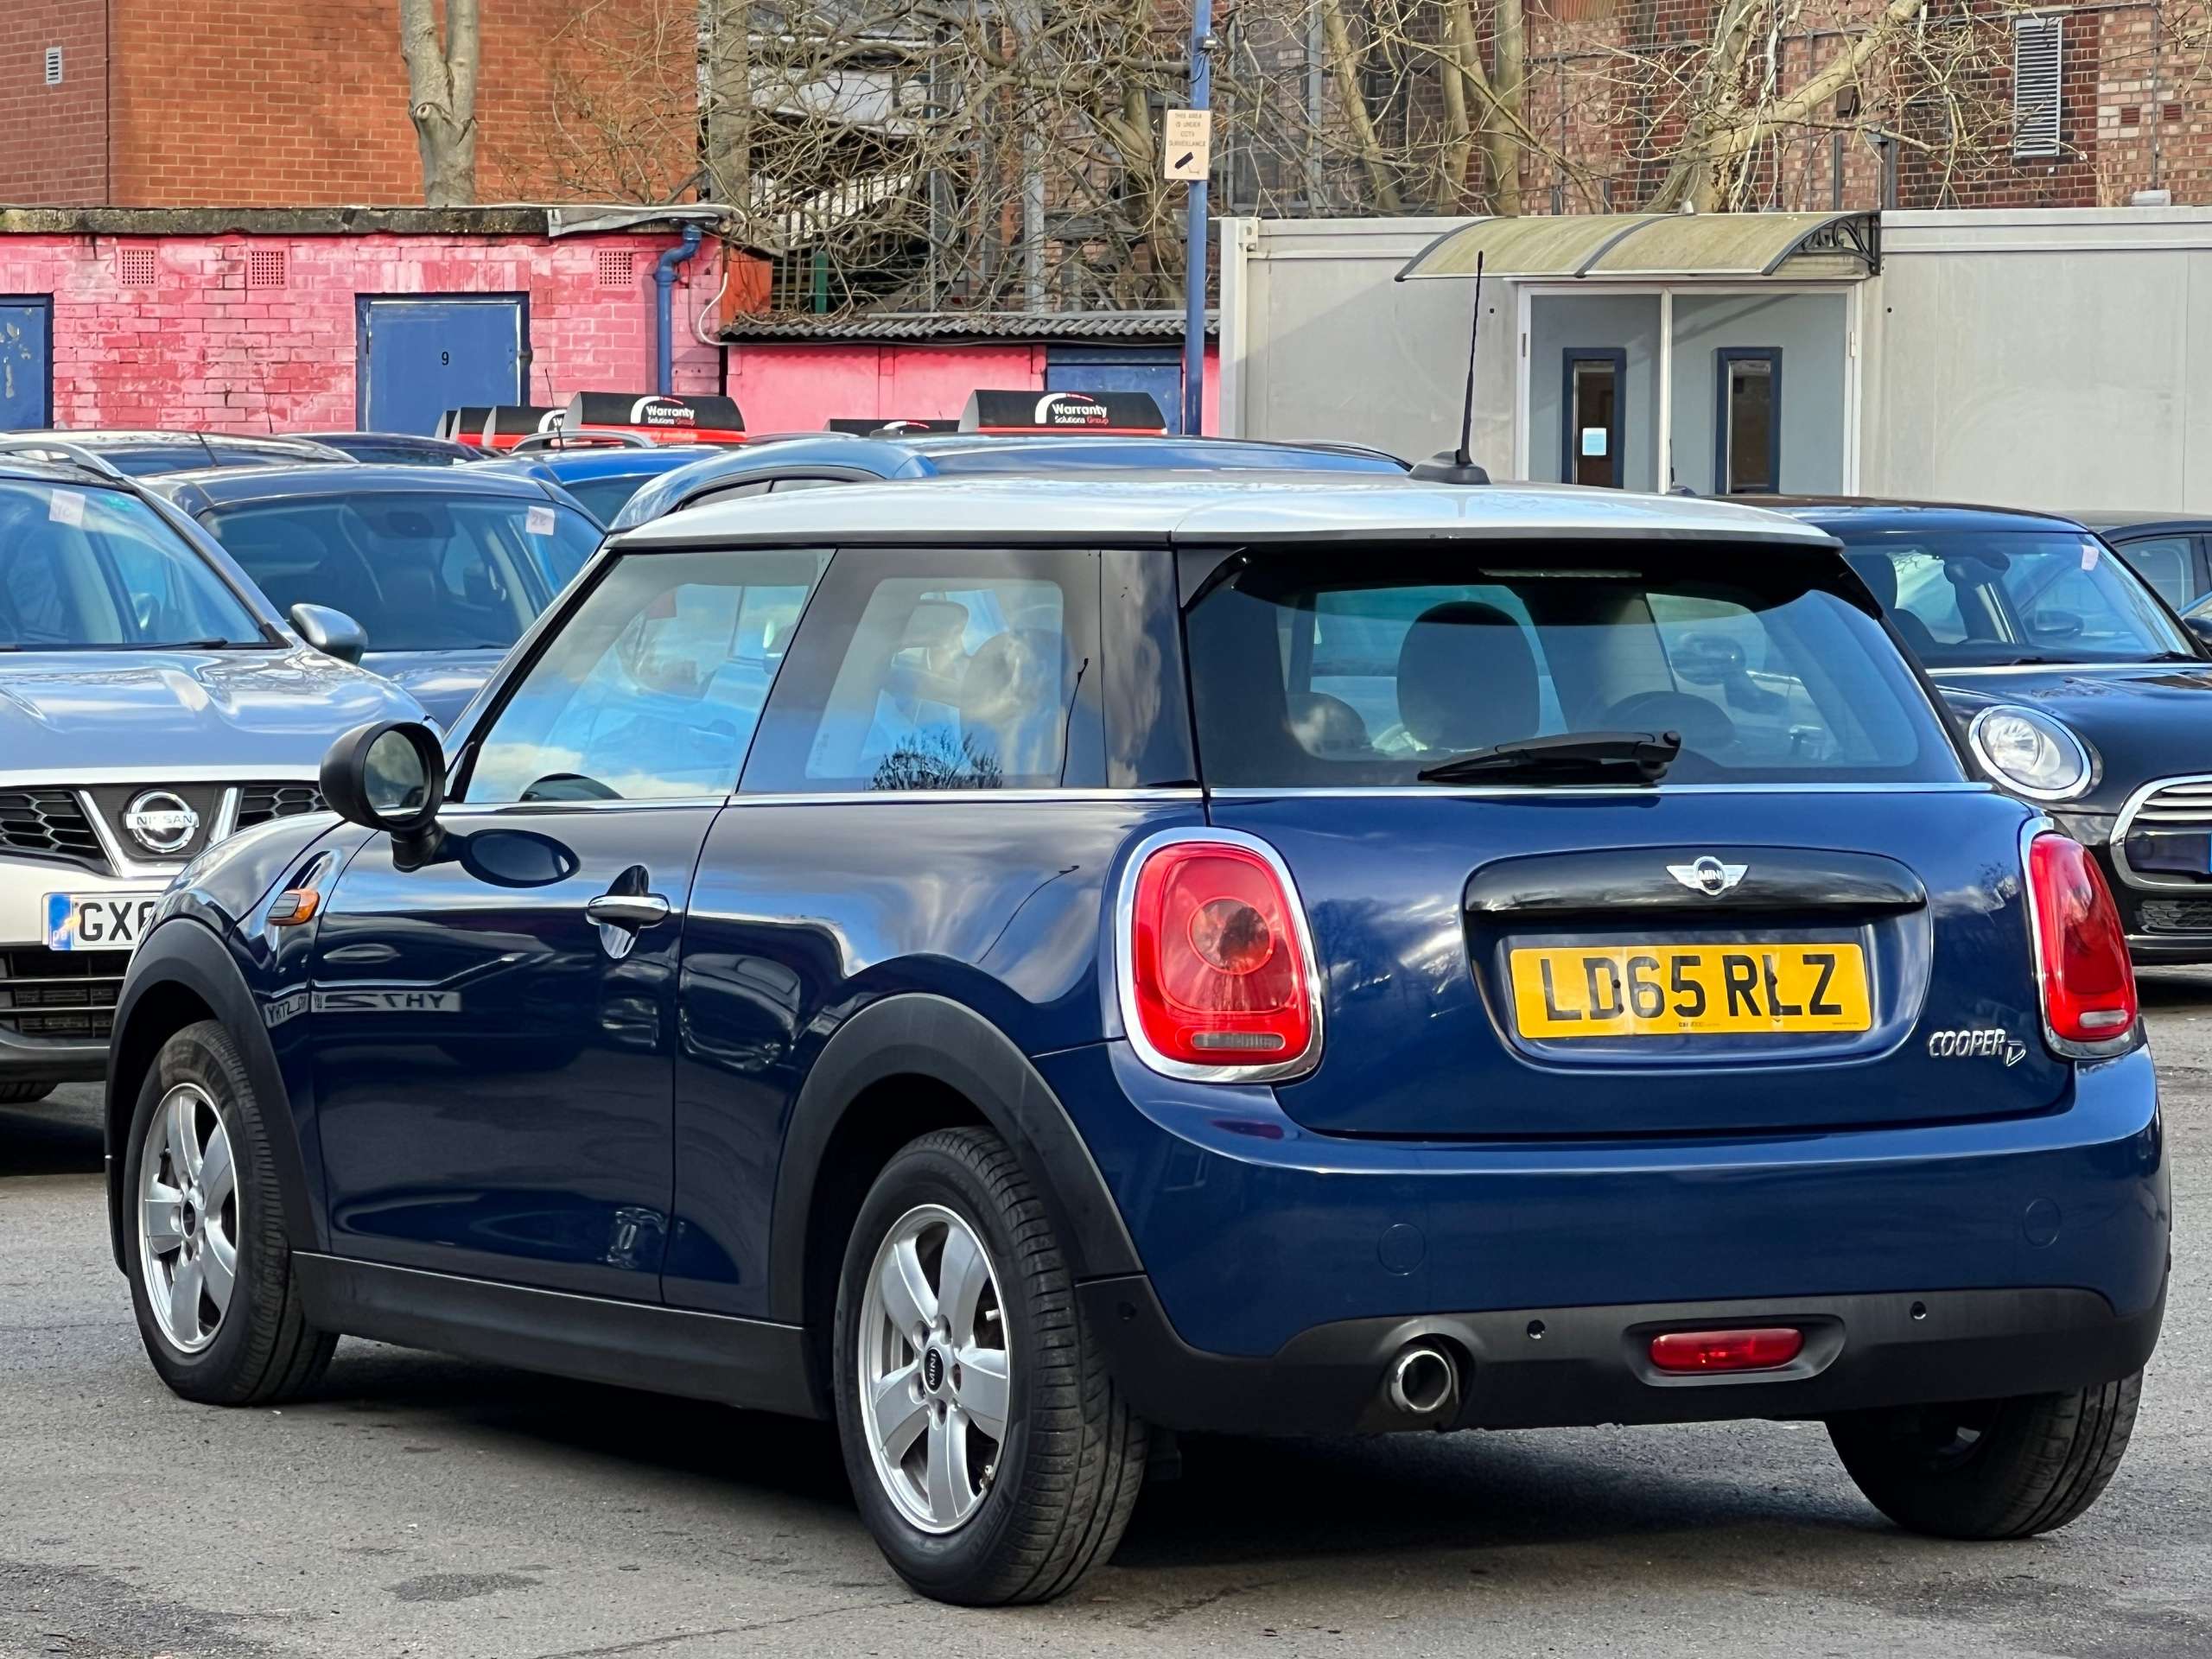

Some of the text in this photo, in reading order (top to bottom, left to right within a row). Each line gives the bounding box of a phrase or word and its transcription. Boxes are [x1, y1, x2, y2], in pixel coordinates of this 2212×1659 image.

[442, 351, 449, 365] 9
[645, 405, 695, 419] Warranty
[1052, 404, 1108, 418] Warranty
[1054, 416, 1109, 425] Solutions Group
[137, 815, 193, 826] NISAN
[1698, 869, 1723, 880] MINI
[1540, 953, 1842, 1021] LD65 RLZ
[1929, 1028, 2027, 1067] COOPER D
